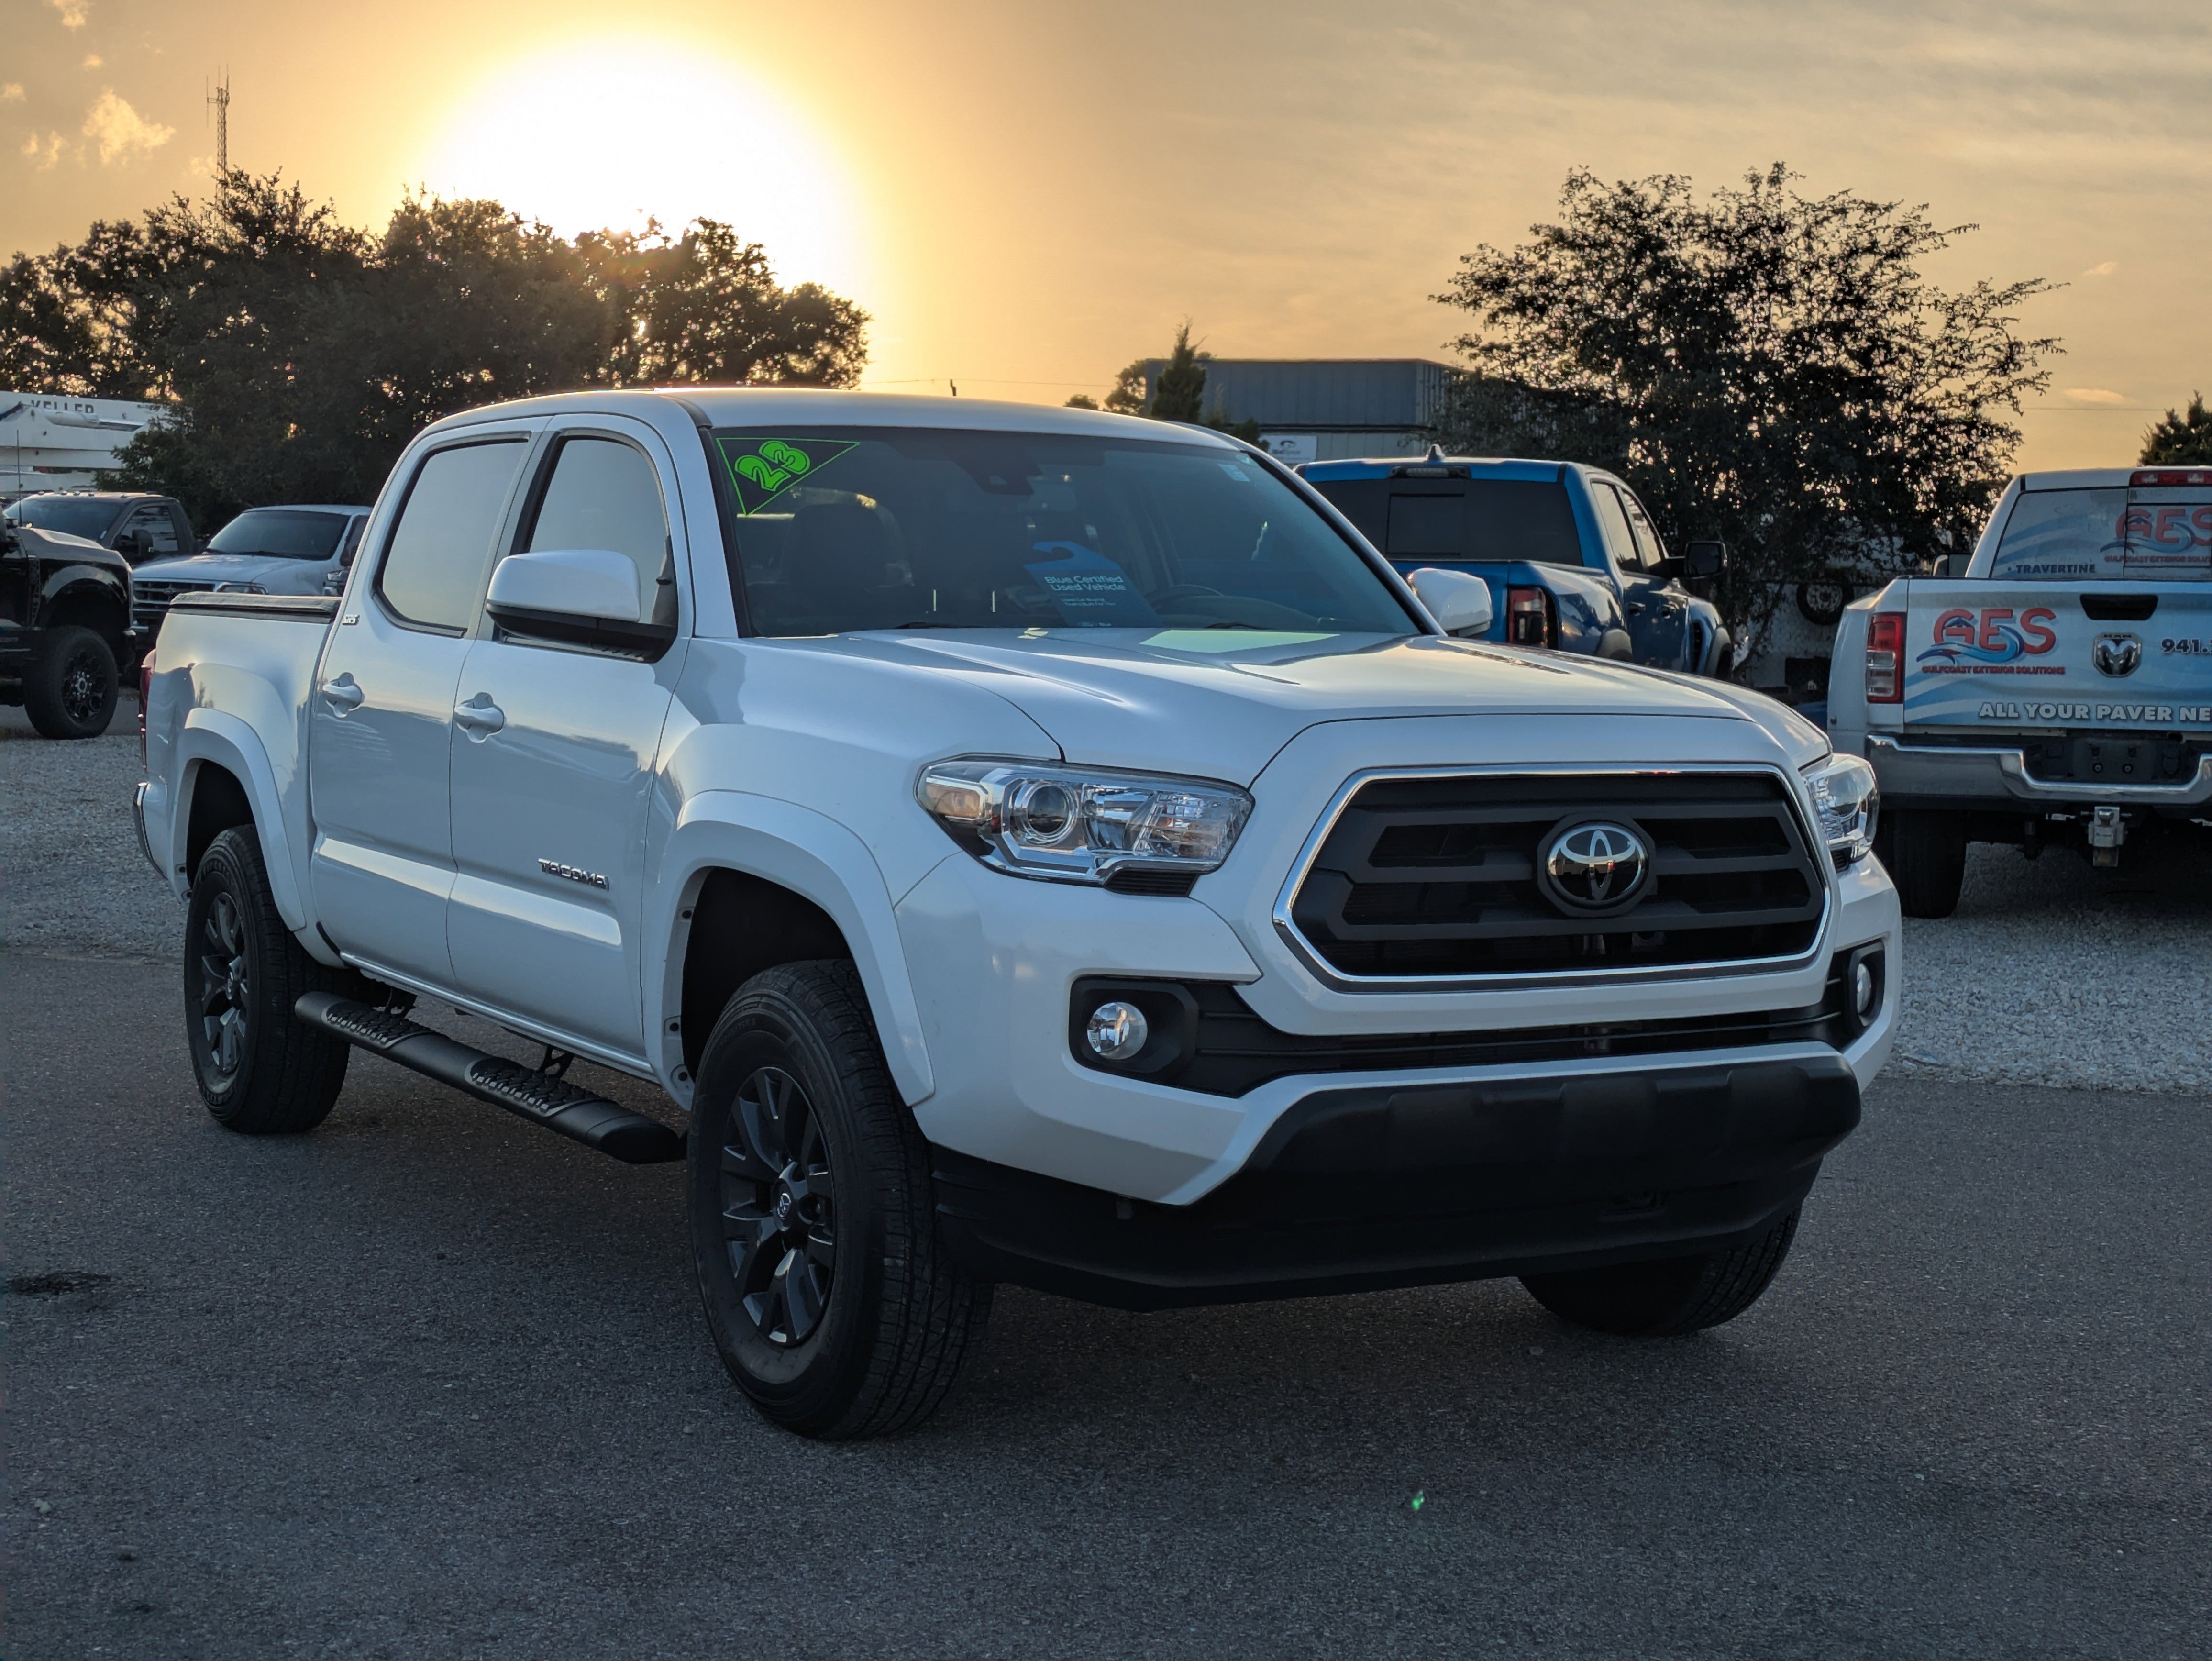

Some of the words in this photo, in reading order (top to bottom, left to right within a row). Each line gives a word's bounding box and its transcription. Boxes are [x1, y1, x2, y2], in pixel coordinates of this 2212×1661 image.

[735, 440, 810, 492] 23
[2016, 564, 2096, 574] TRAVERTINE
[1933, 608, 2057, 655] GES
[2161, 638, 2212, 654] 941.
[1922, 665, 1972, 674] GULFCOAST
[1973, 666, 2014, 674] EXTERIOR
[2015, 666, 2066, 675] SOLUTIONS
[1979, 702, 2019, 718] ALL
[2024, 703, 2090, 719] YOUR
[2097, 704, 2172, 721] PAVER
[538, 858, 610, 891] TACOMA
